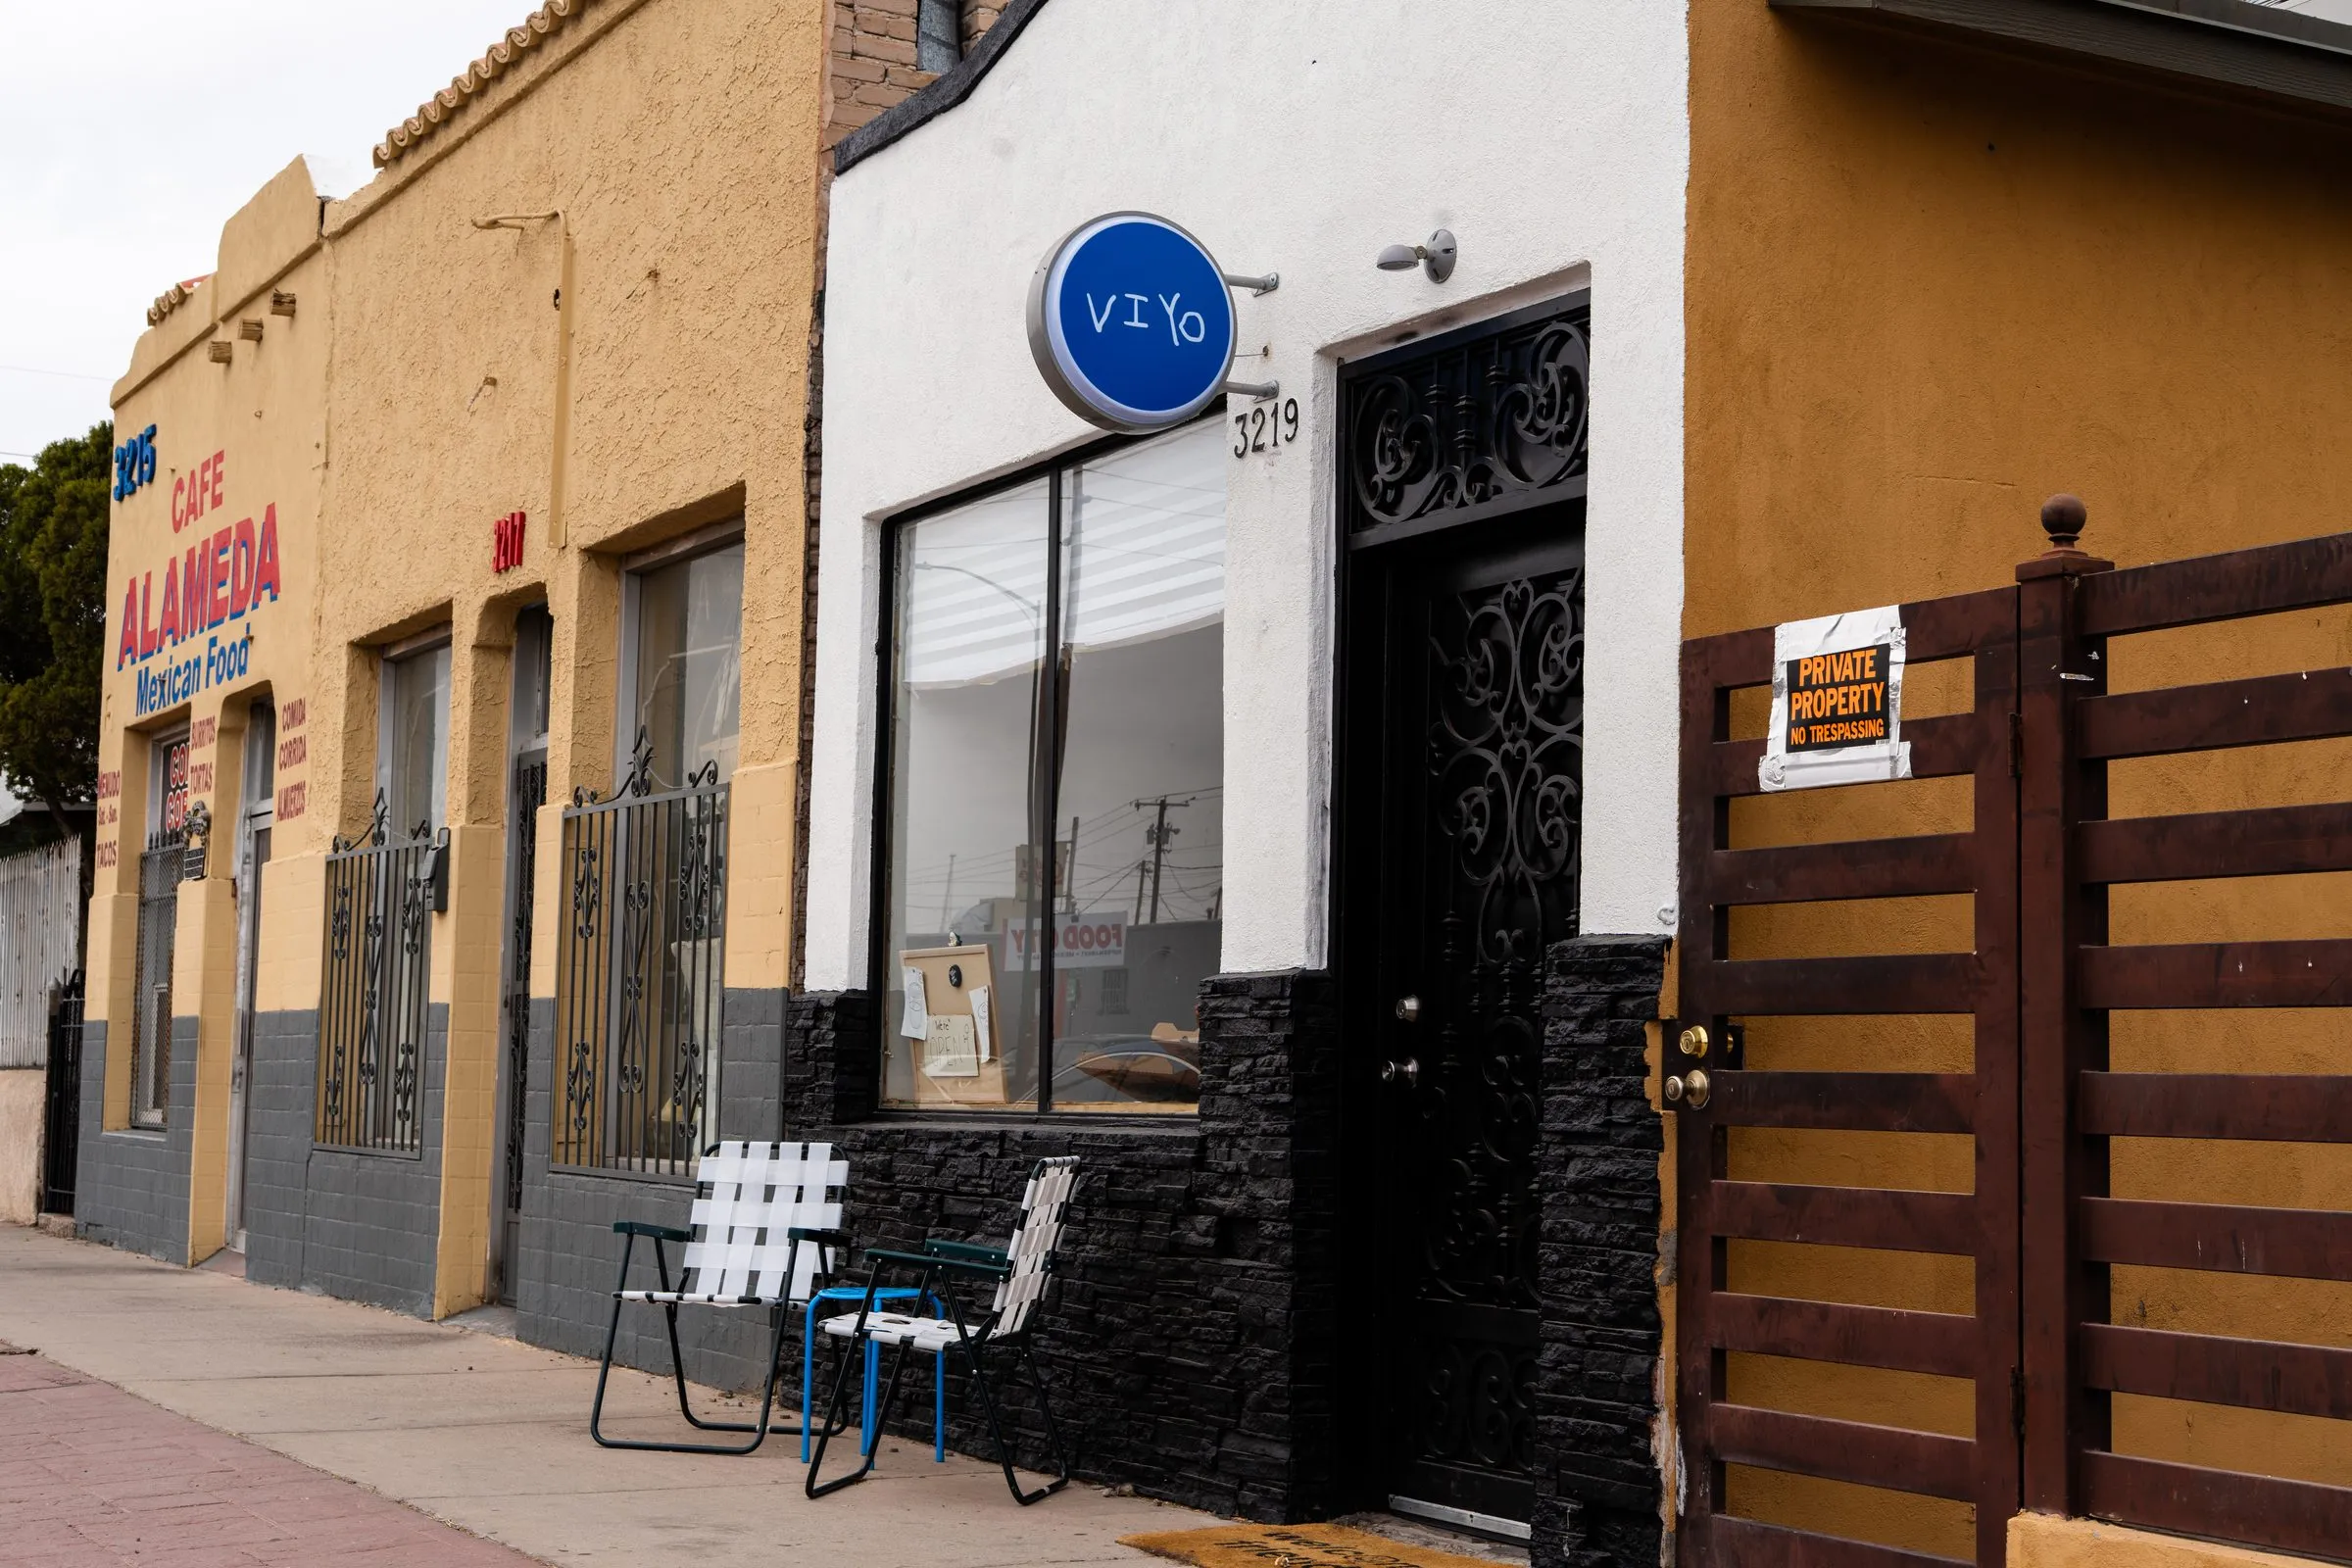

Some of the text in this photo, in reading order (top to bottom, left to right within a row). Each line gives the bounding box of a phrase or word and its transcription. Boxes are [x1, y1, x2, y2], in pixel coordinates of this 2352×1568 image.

[1234, 398, 1299, 459] 3219
[113, 423, 157, 502] 3215
[171, 449, 224, 534] CAFE
[492, 511, 526, 573] 3217
[118, 501, 281, 672] ALAMEDA
[135, 622, 252, 717] Mexican Food
[1799, 649, 1878, 687] PRIVATE
[1790, 681, 1885, 721] PROPERTY
[1790, 717, 1885, 745] NO TRESPASSING
[97, 840, 117, 869] TACOS
